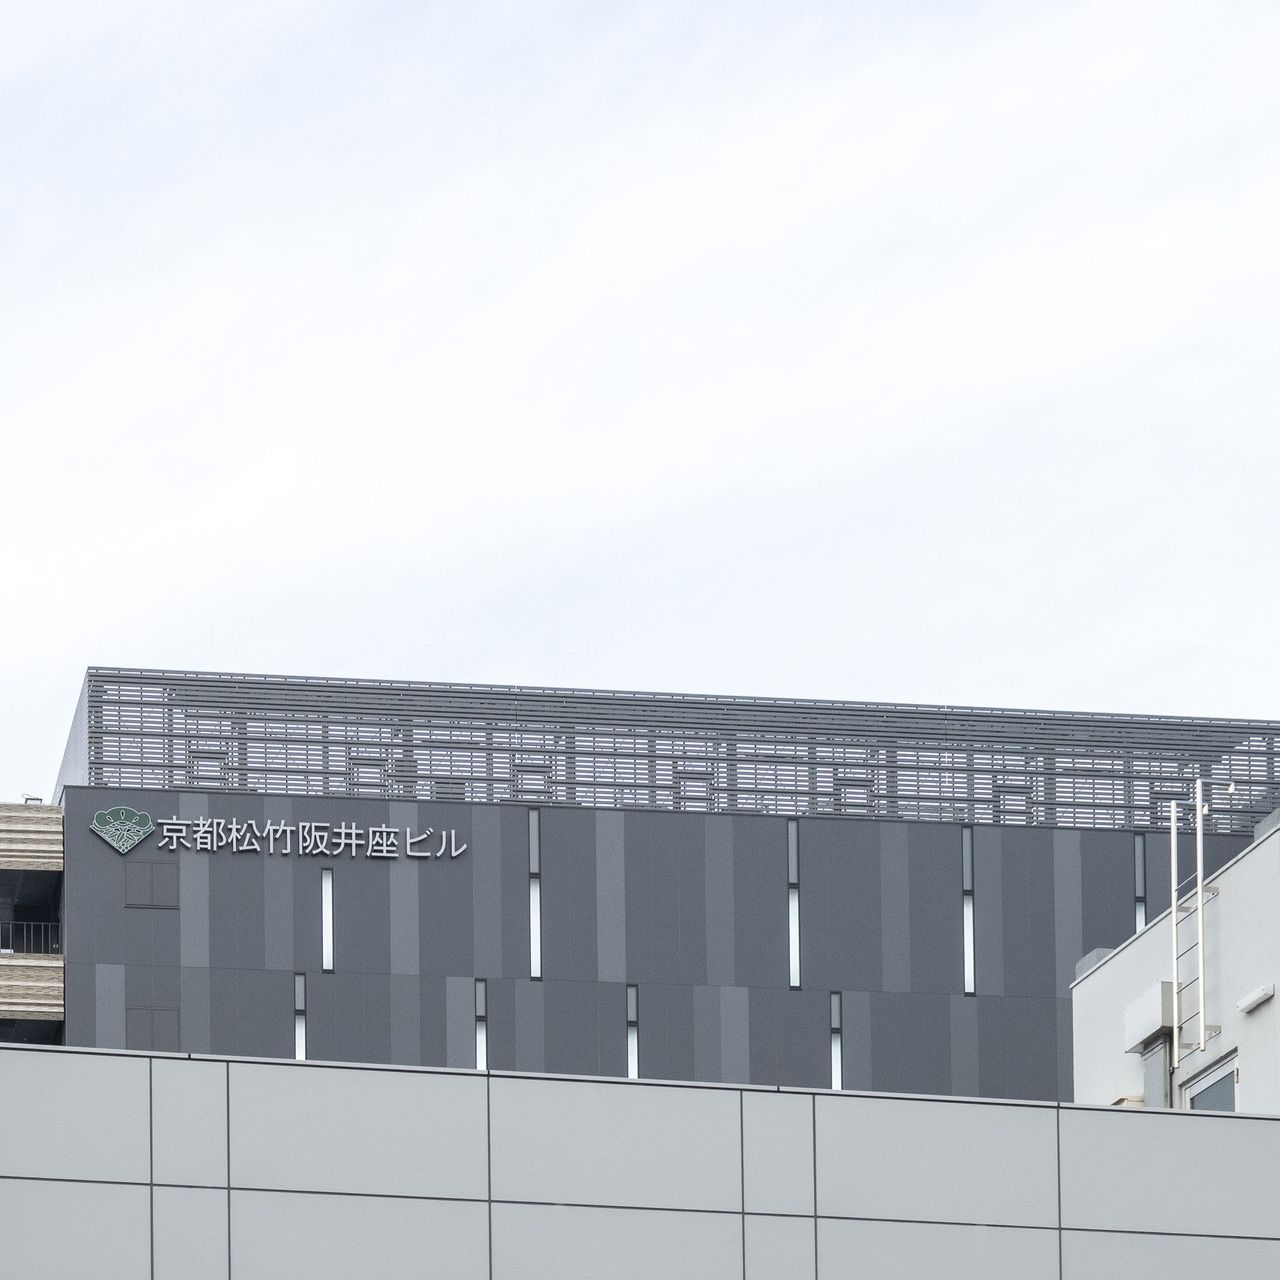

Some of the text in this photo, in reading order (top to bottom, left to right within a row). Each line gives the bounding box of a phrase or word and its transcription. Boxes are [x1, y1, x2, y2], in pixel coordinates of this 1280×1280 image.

[157, 815, 468, 858] 京都松竹阪井座ビル
